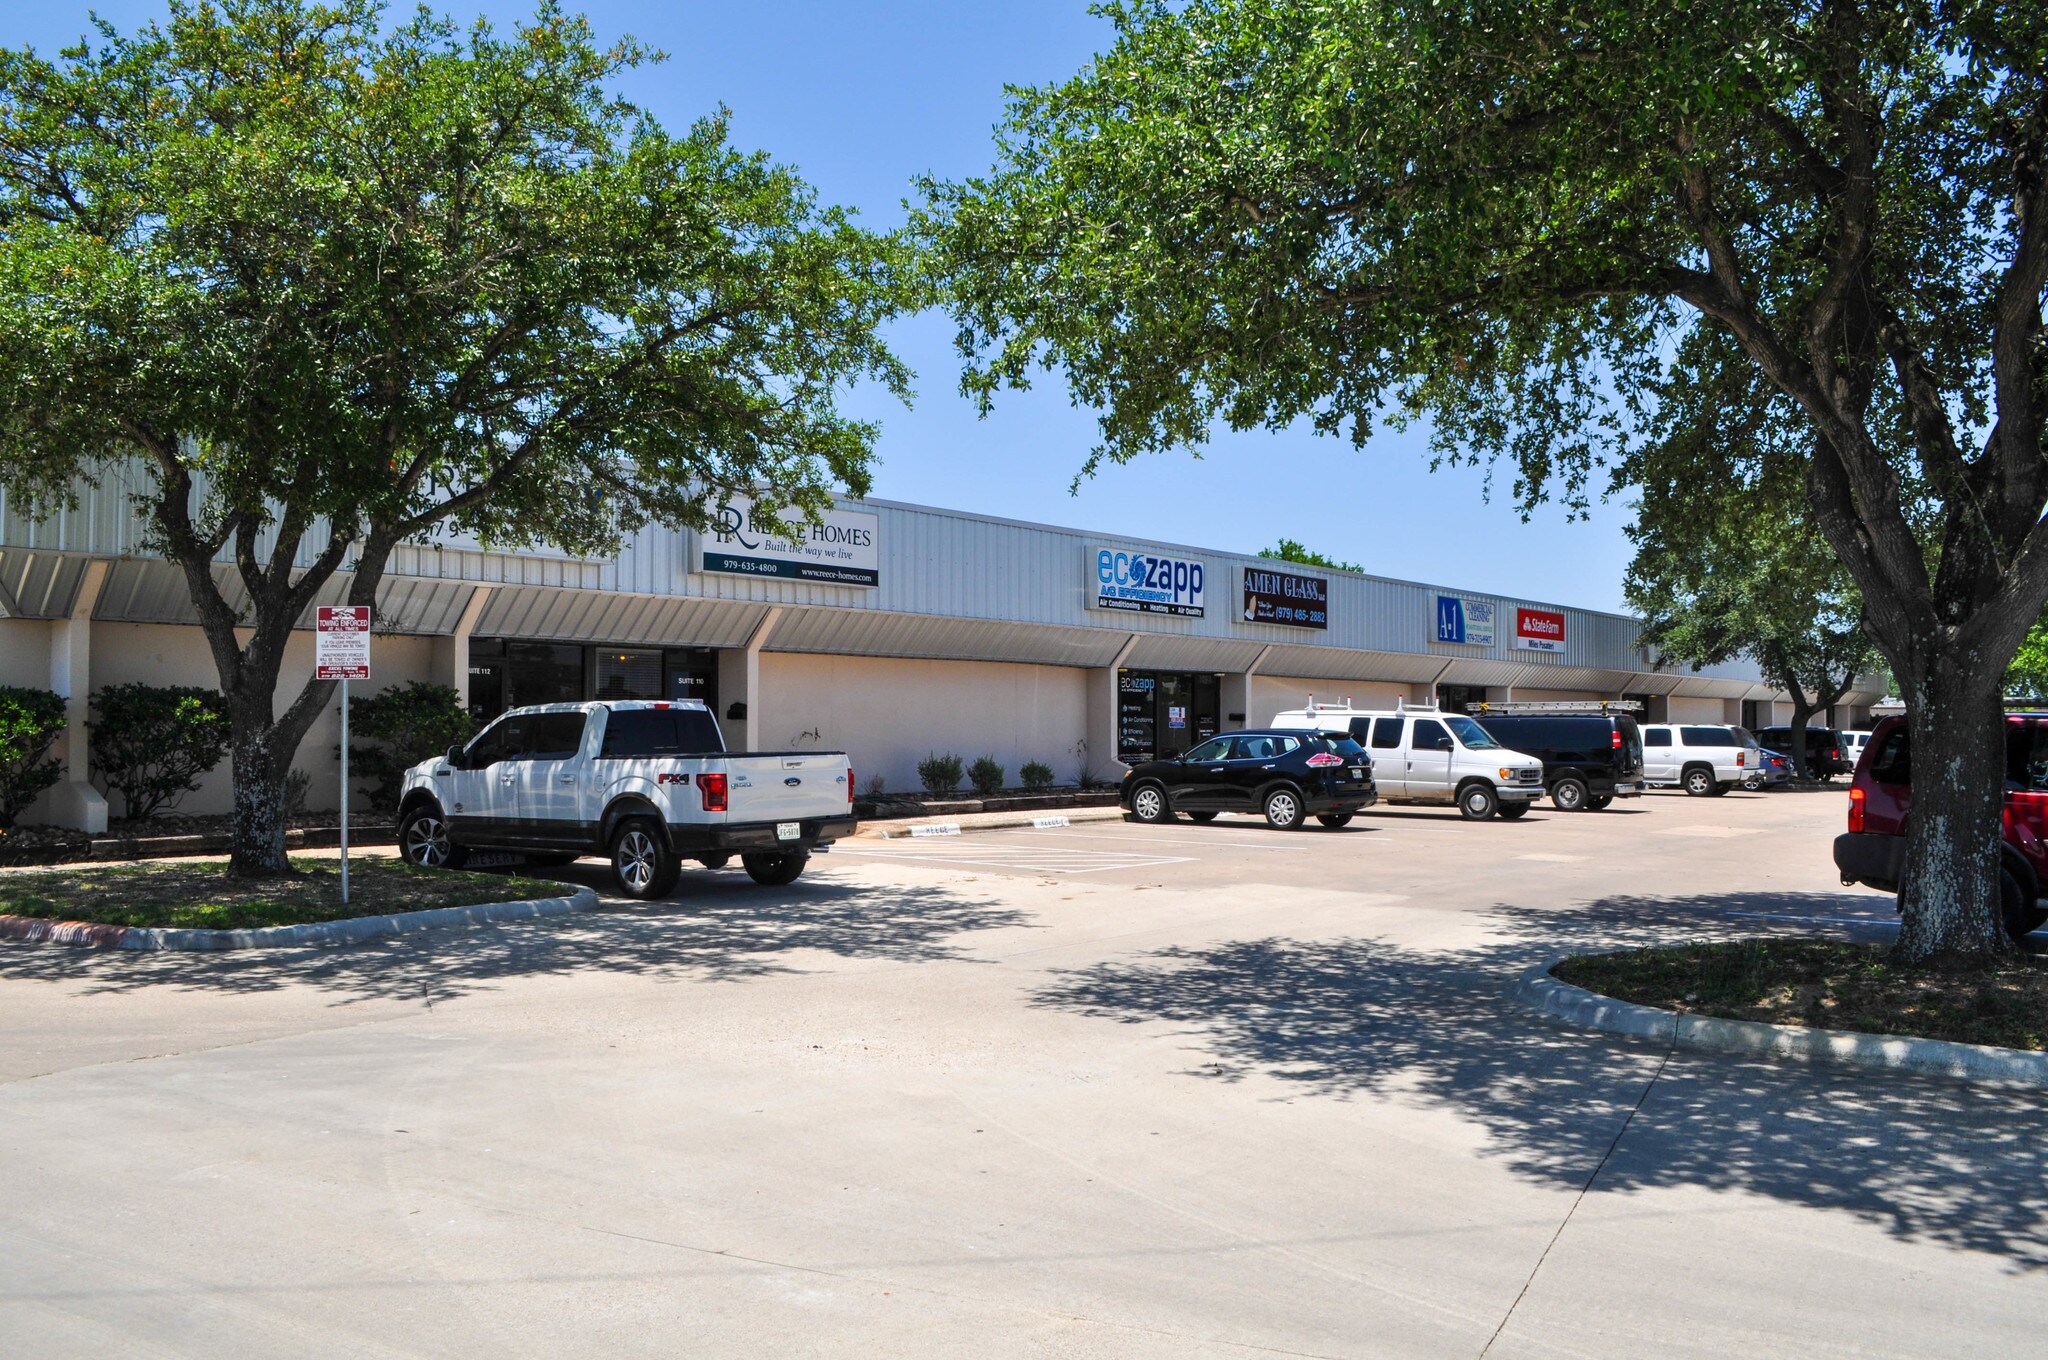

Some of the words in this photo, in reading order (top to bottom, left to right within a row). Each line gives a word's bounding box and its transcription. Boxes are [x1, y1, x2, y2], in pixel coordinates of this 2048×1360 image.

[748, 513, 806, 539] REE
[813, 523, 871, 546] HOMES
[765, 539, 786, 553] Built
[789, 543, 802, 554] the
[804, 546, 821, 559] way
[825, 549, 836, 559] we
[838, 547, 853, 560] live
[723, 559, 777, 573] 979-635-4800
[801, 567, 872, 583] www.reece-homes.com
[1101, 585, 1117, 597] A/C
[1118, 588, 1173, 603] EFFICIENCY
[1244, 571, 1281, 596] AMEN
[1284, 576, 1318, 600] GLASS
[1108, 600, 1141, 611] Conditioning
[1150, 604, 1169, 613] Heating
[1275, 606, 1293, 621] (979)
[1439, 602, 1458, 640] A-1
[1468, 611, 1490, 623] CLEANING
[658, 774, 690, 784] FX4
